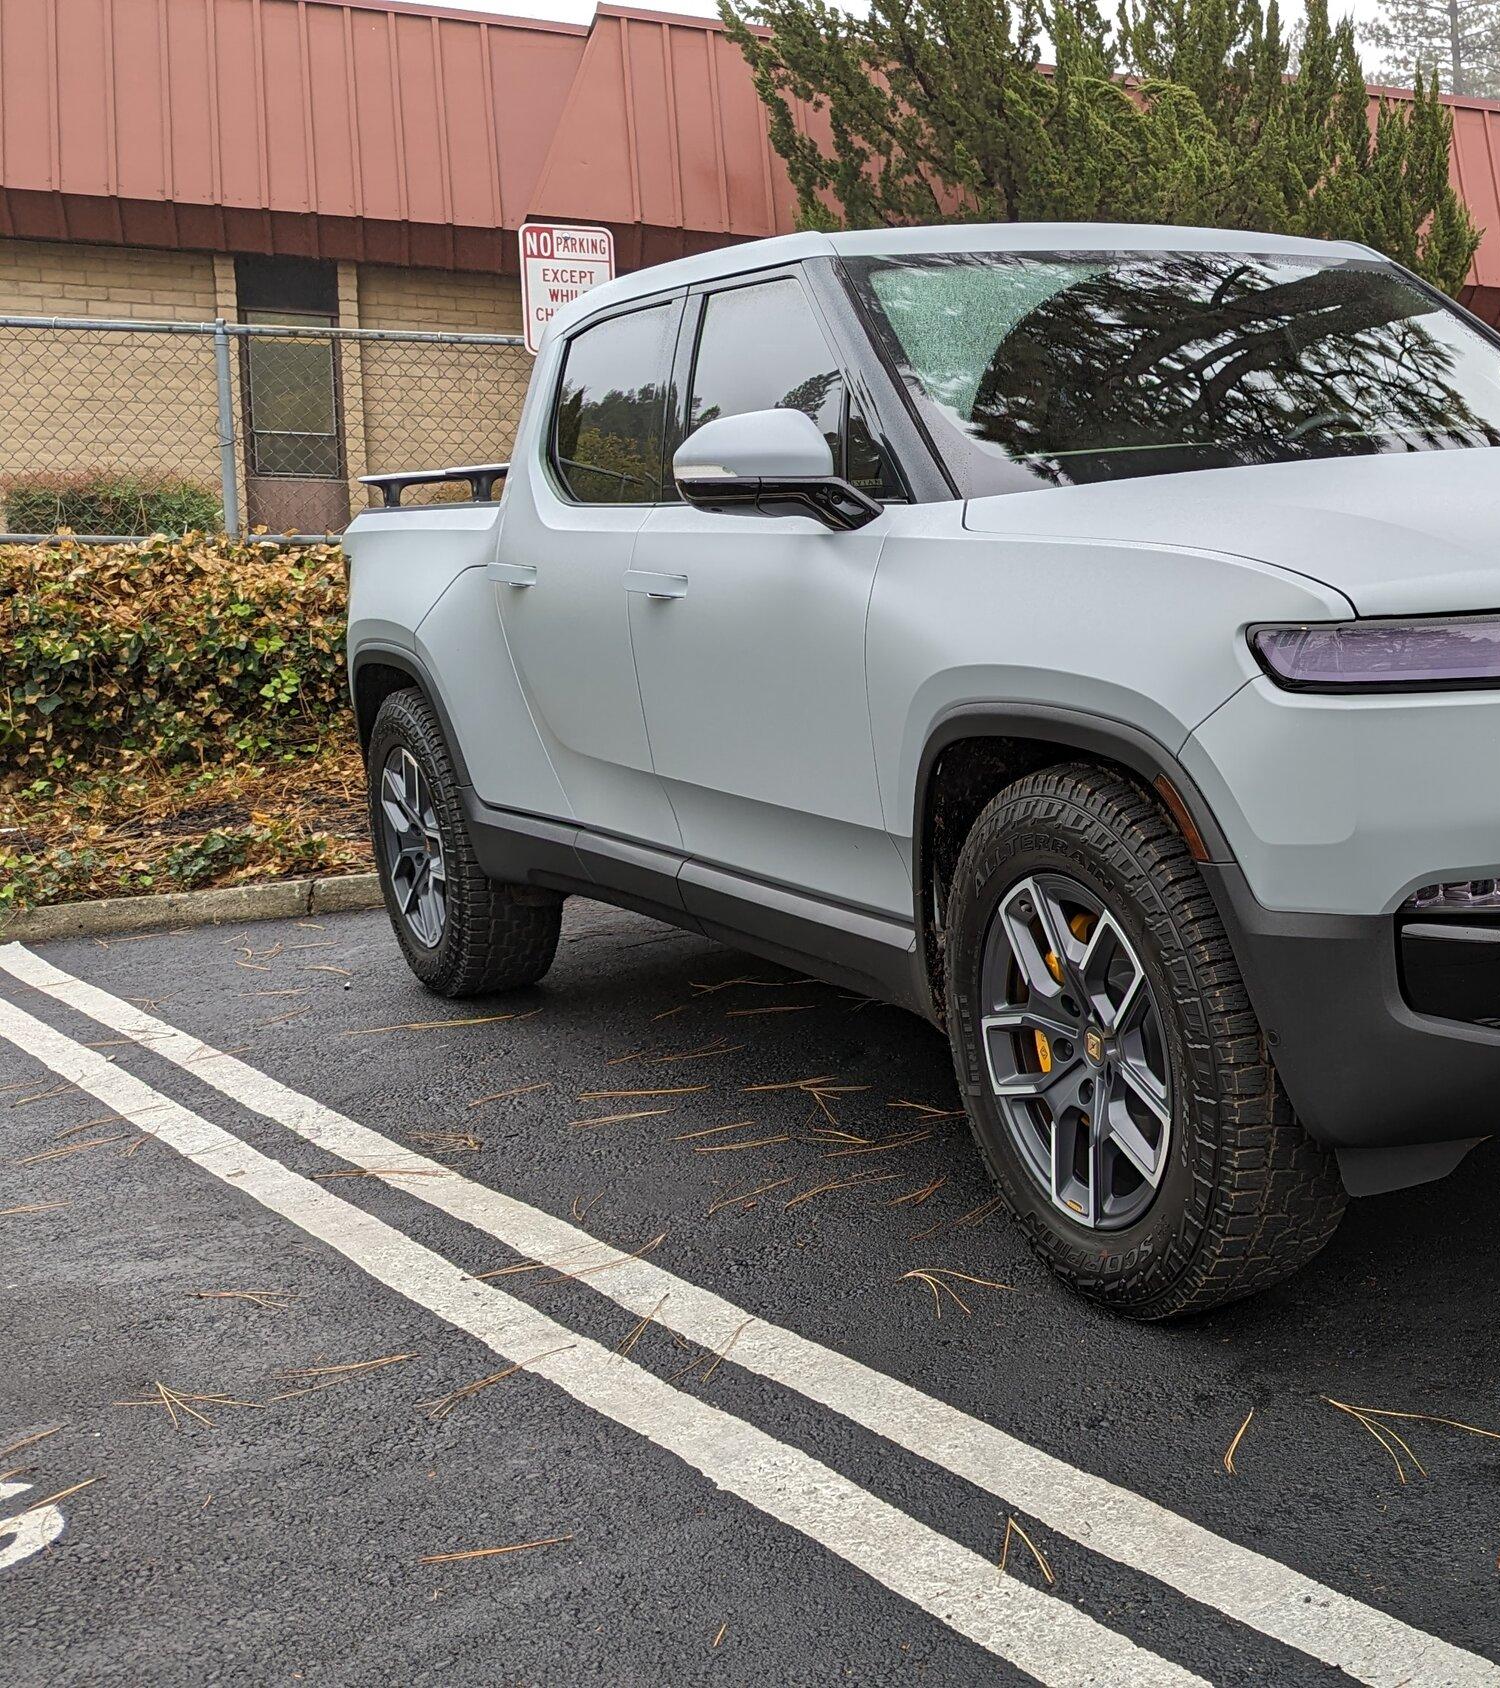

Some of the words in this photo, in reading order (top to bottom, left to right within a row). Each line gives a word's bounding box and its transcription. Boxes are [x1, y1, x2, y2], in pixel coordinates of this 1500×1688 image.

[525, 231, 552, 256] NO
[556, 236, 606, 255] PARKING
[542, 268, 595, 284] EXCEPT
[549, 289, 589, 303] WHI
